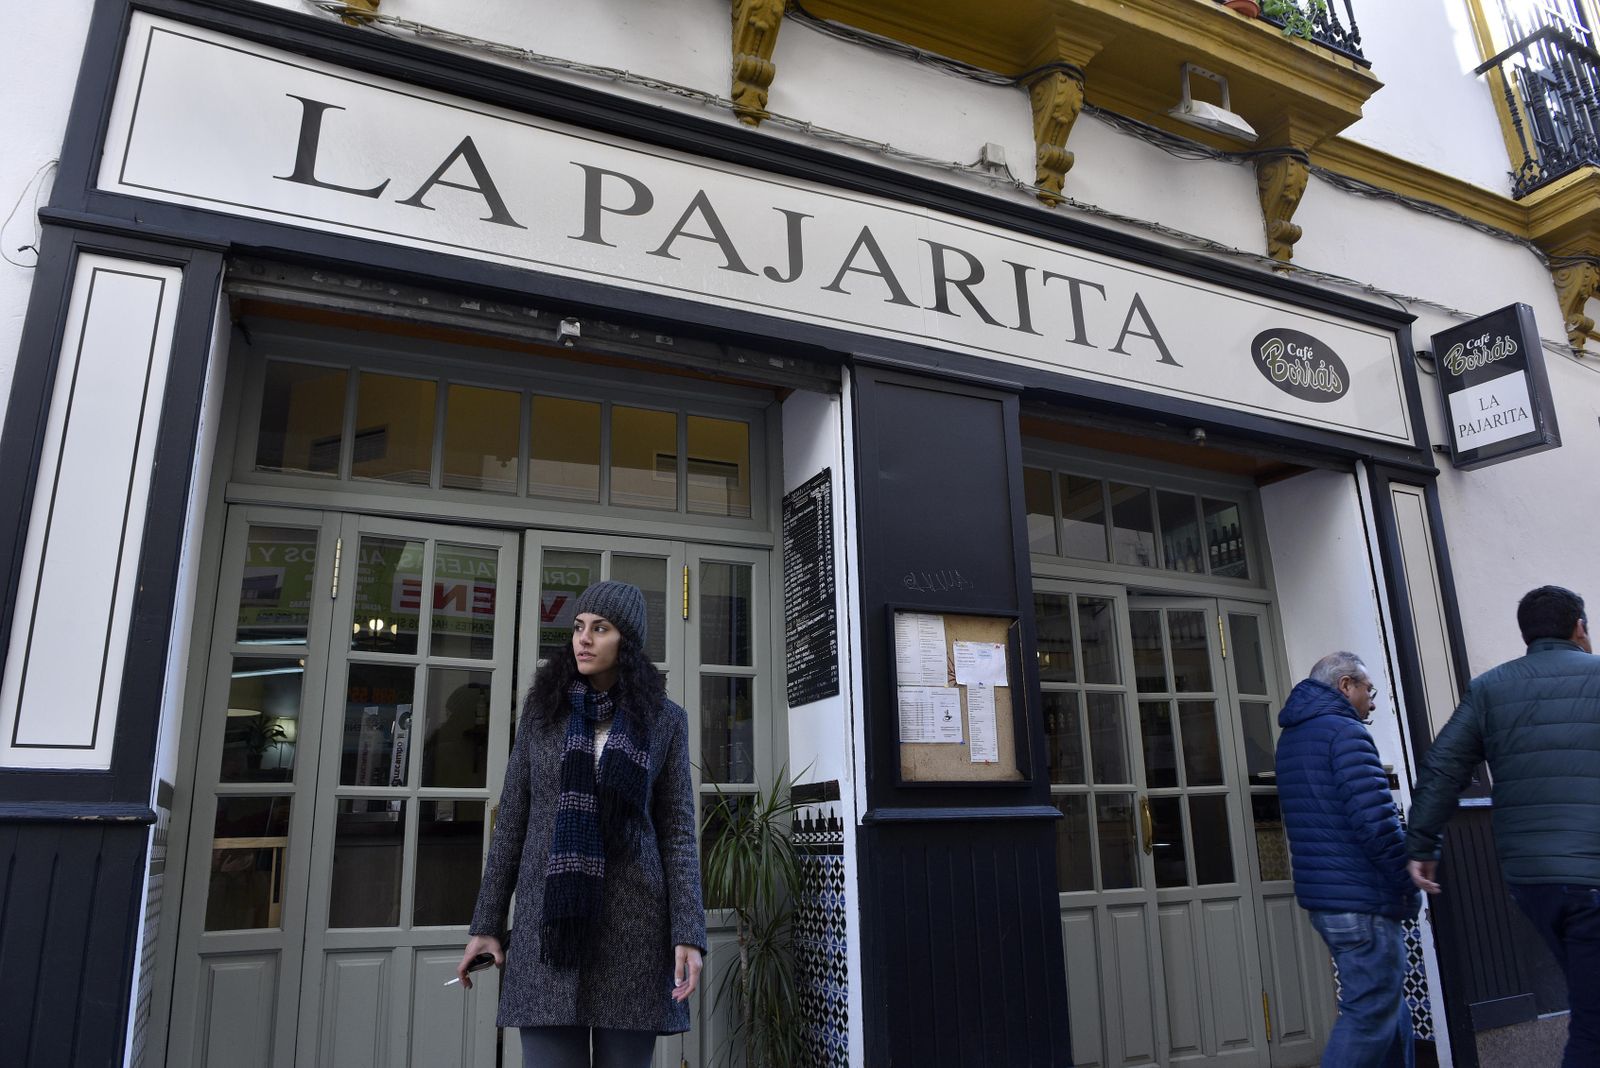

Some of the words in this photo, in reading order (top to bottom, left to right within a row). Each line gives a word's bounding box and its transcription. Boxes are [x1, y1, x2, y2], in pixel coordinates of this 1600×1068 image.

[273, 93, 528, 229] LA
[567, 161, 1184, 368] PAJARITA
[1287, 342, 1313, 360] Café
[1443, 335, 1518, 376] Borrás
[1466, 333, 1490, 350] Café
[1260, 337, 1343, 394] Borrás
[1479, 394, 1500, 411] LA
[1459, 407, 1529, 438] PAJARITA
